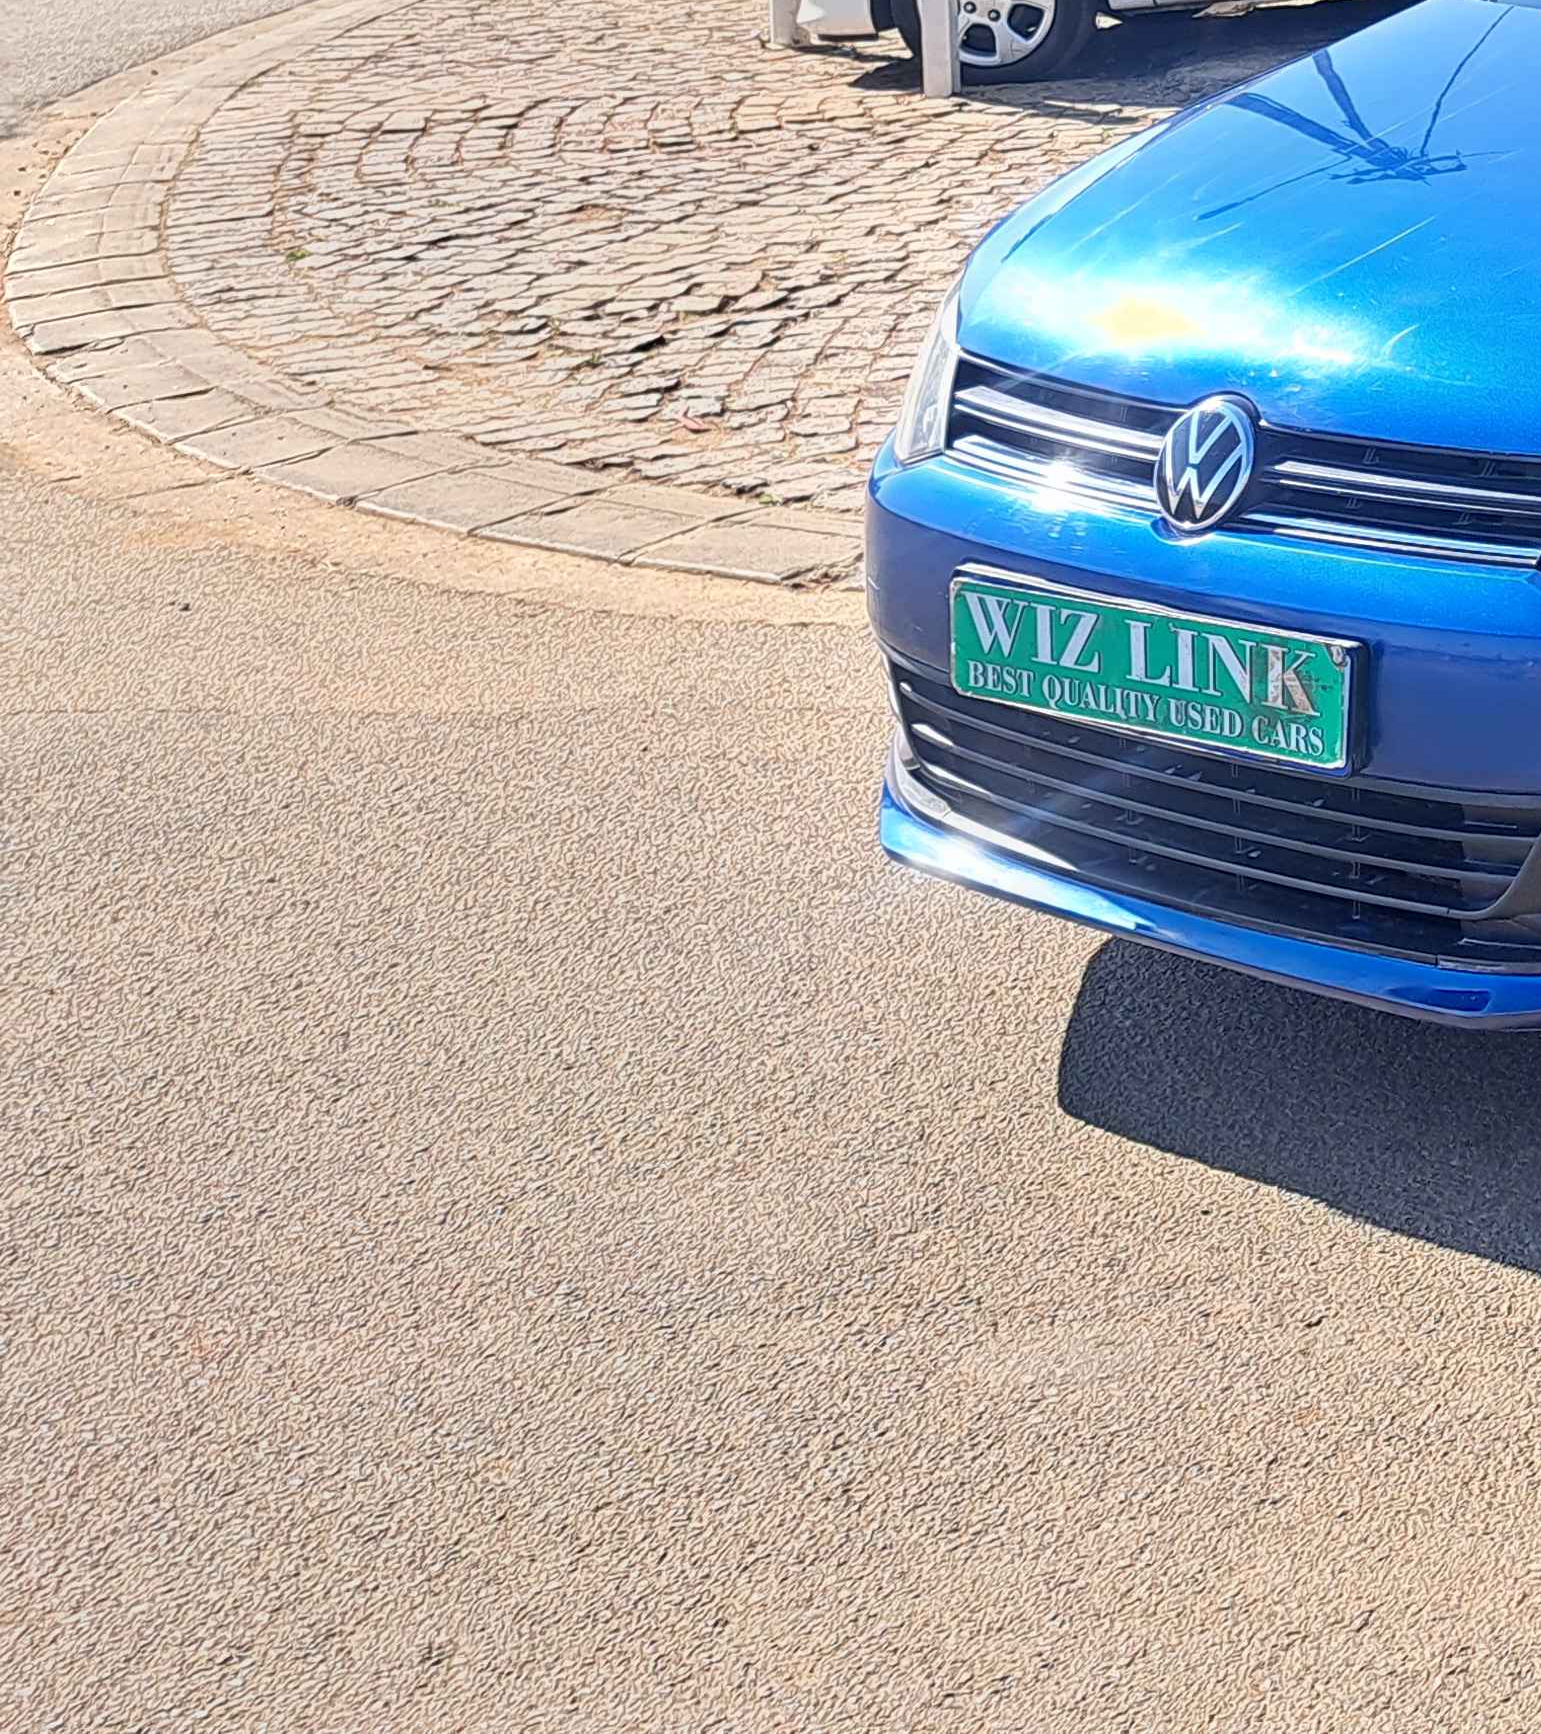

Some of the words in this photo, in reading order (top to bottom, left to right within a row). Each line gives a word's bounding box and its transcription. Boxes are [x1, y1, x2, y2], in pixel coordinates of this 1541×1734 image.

[959, 590, 1100, 674] WIZ
[1124, 619, 1321, 717] LINK
[967, 659, 1035, 698] BEST
[1042, 674, 1159, 722] QUALITY
[1168, 697, 1243, 739] USED
[1252, 715, 1325, 756] CARS
